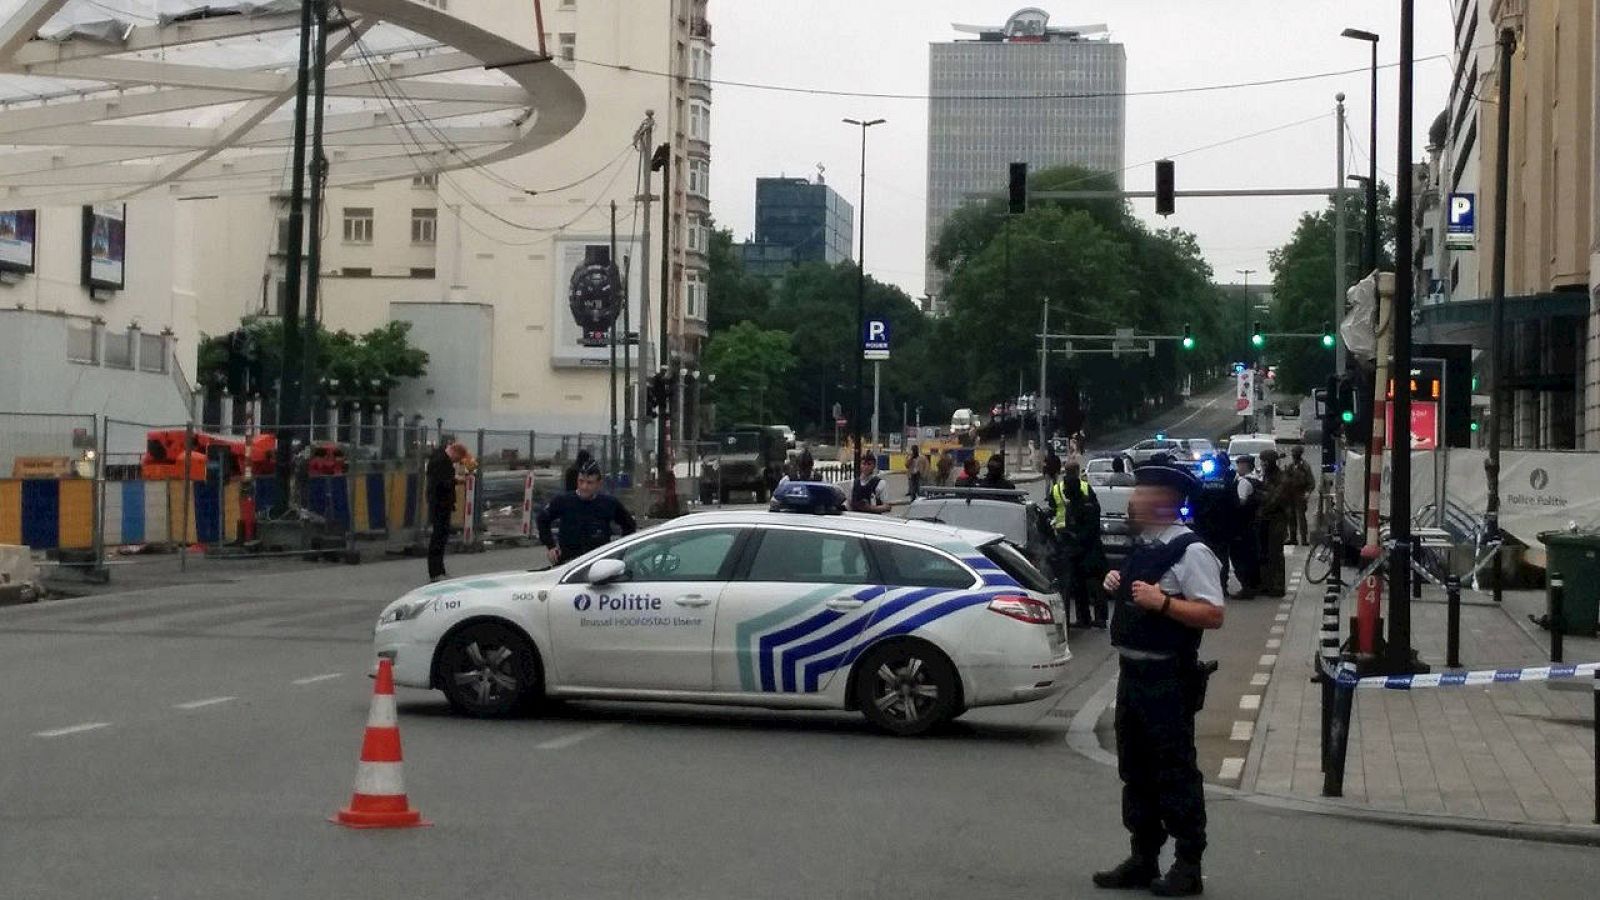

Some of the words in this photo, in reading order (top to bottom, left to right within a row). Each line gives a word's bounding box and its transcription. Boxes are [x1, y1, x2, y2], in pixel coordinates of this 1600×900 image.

[1452, 197, 1470, 223] P
[1509, 495, 1533, 504] Police
[1537, 496, 1567, 505] Politie
[512, 592, 534, 600] 505
[446, 601, 460, 609] 101
[599, 594, 661, 610] Politie
